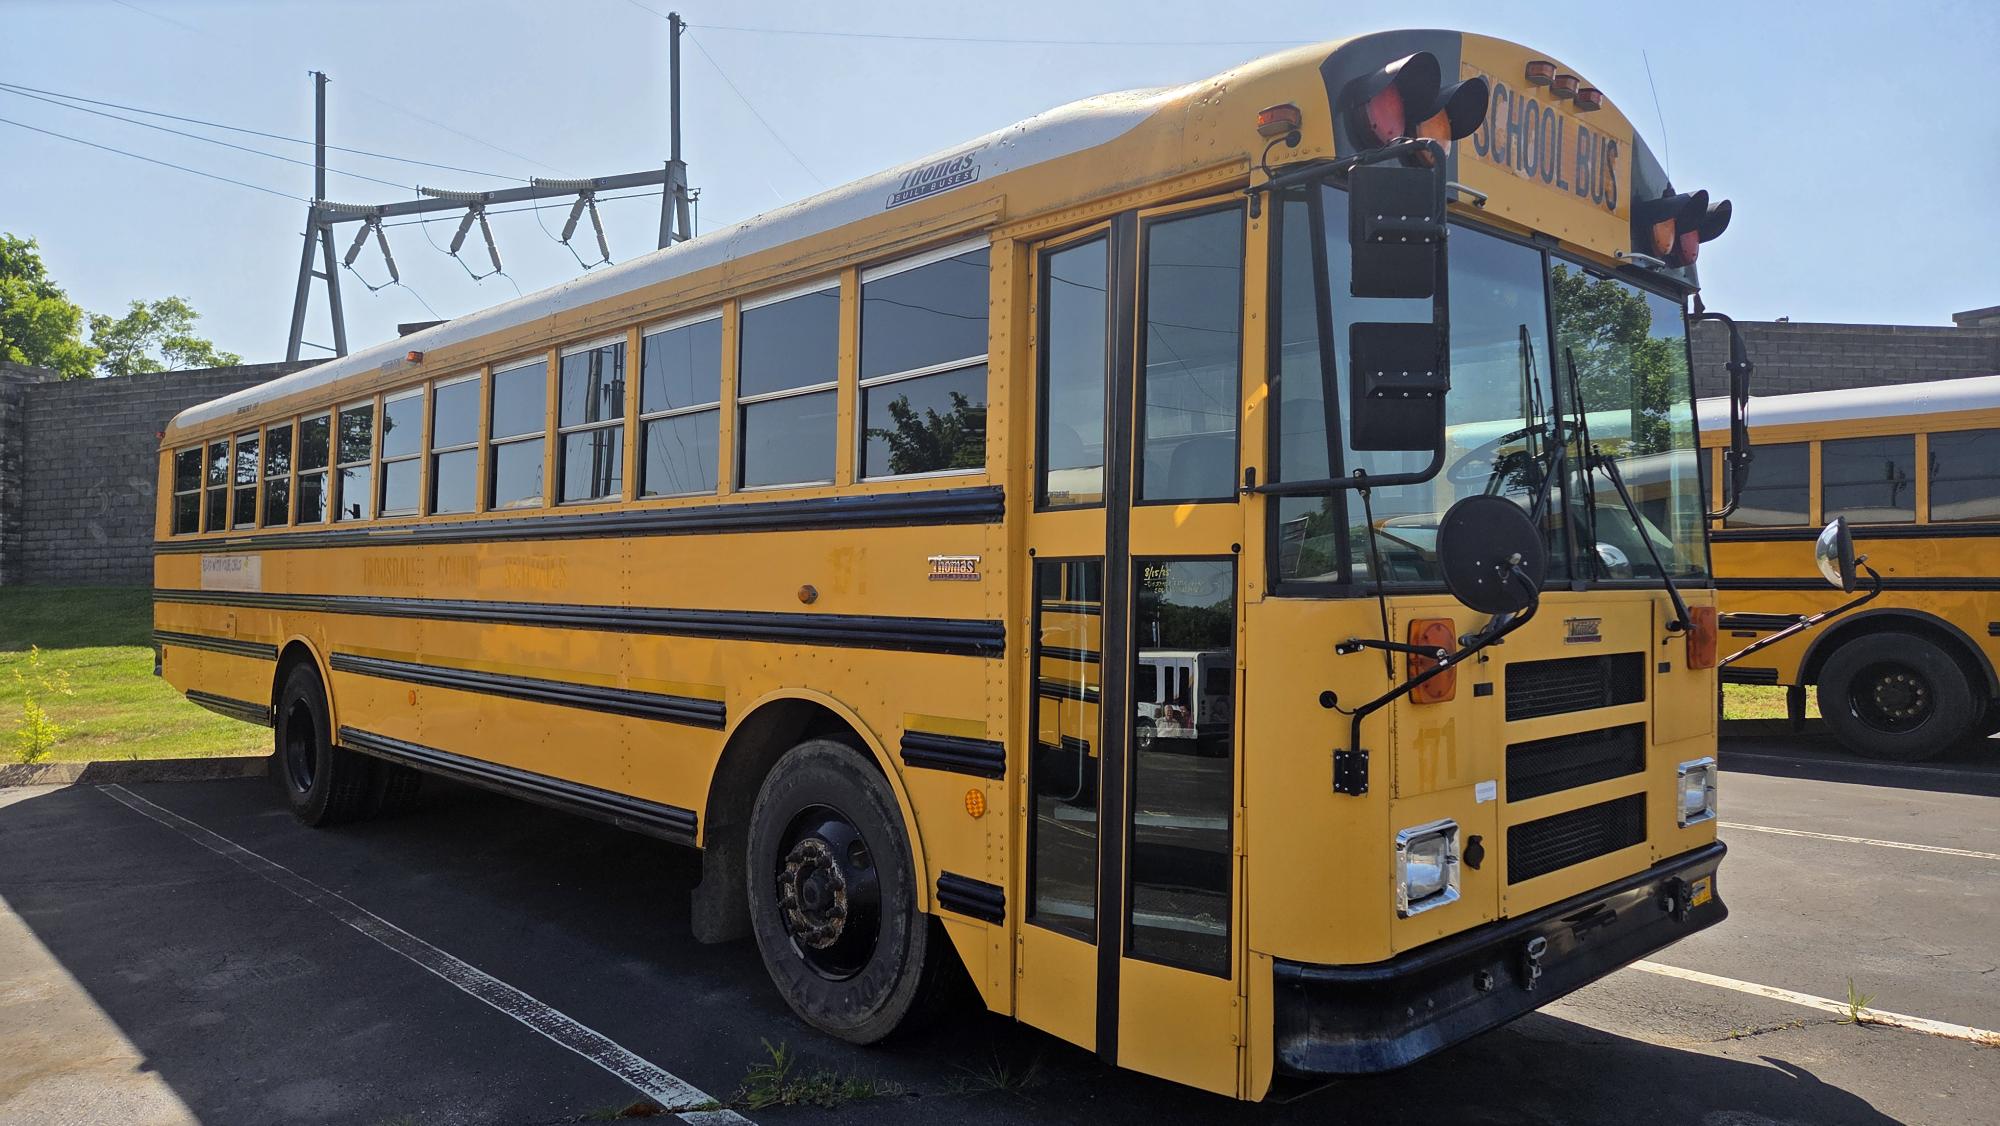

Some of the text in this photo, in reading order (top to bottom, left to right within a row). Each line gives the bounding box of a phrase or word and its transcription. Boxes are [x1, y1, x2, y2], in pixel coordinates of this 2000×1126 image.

[898, 150, 977, 191] Thomas
[1576, 125, 1618, 211] BUS
[894, 171, 970, 202] BUILT BUSES
[928, 554, 982, 573] Thomas
